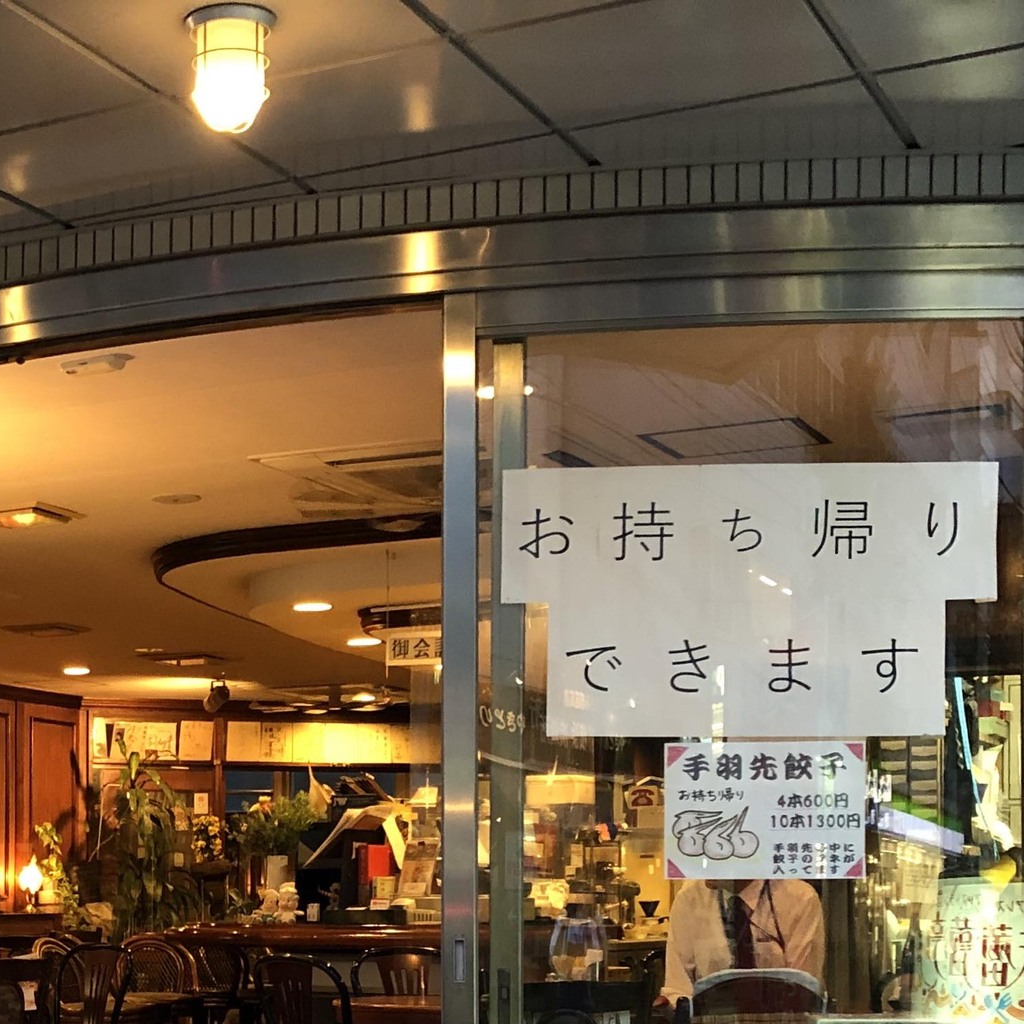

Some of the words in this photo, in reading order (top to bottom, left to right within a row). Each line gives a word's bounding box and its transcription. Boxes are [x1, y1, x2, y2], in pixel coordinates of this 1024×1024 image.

[517, 499, 960, 562] お持ち帰り
[565, 637, 920, 694] できます
[681, 751, 847, 781] 手羽先餃子
[677, 787, 745, 802] お持ち帰り
[777, 793, 849, 808] 4本600円
[770, 813, 861, 829] 10本1300円
